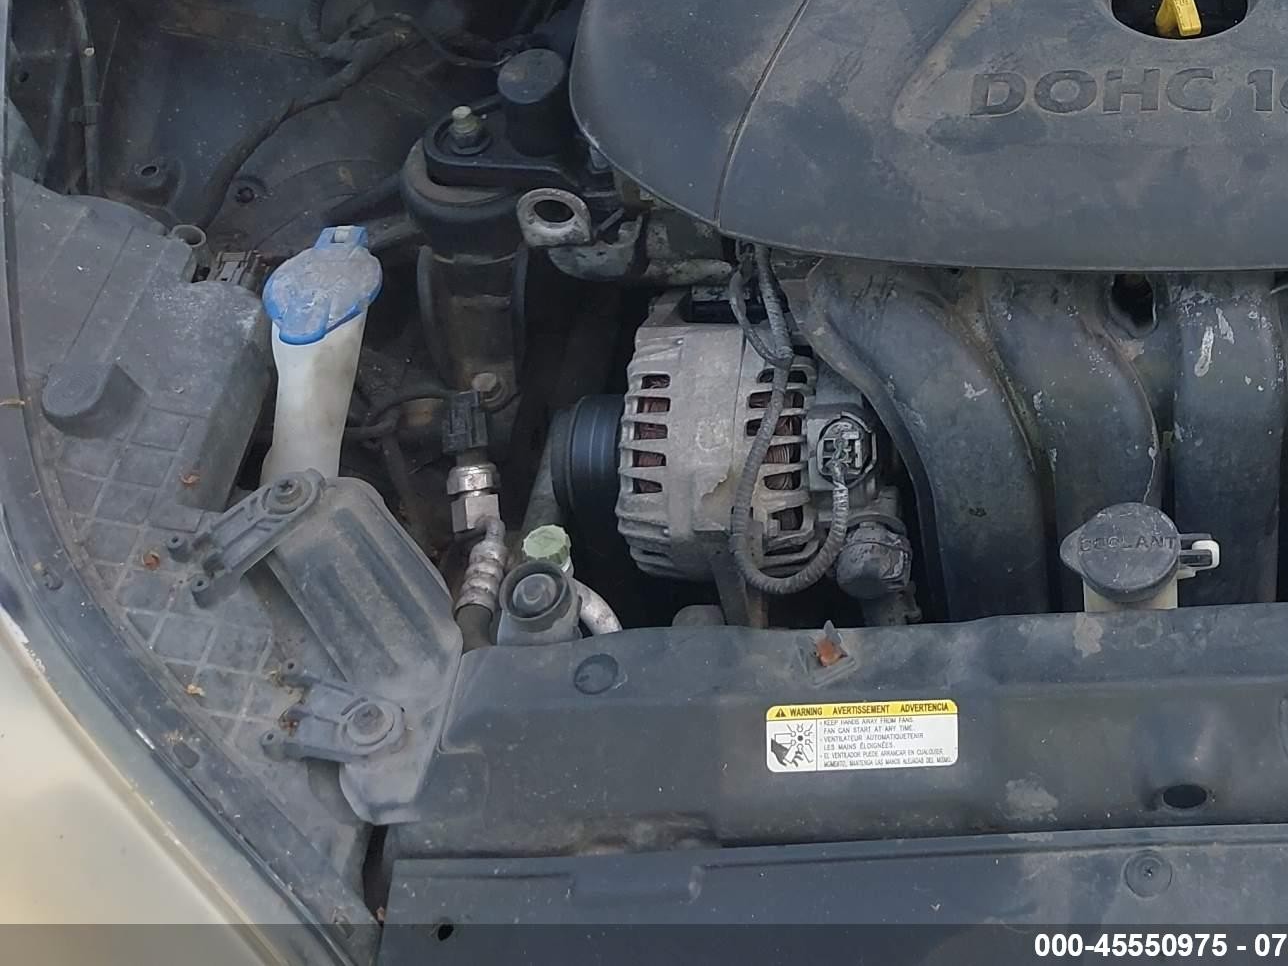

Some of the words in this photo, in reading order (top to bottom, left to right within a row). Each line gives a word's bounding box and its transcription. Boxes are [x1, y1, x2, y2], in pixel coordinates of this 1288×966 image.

[970, 67, 1216, 117] DOHC
[1079, 536, 1178, 552] COOLANT
[790, 707, 823, 717] WARNING
[832, 704, 891, 715] AVERTISSEMENT
[900, 702, 949, 713] ADVERTENCIA
[824, 735, 863, 743] VENTILATEUR
